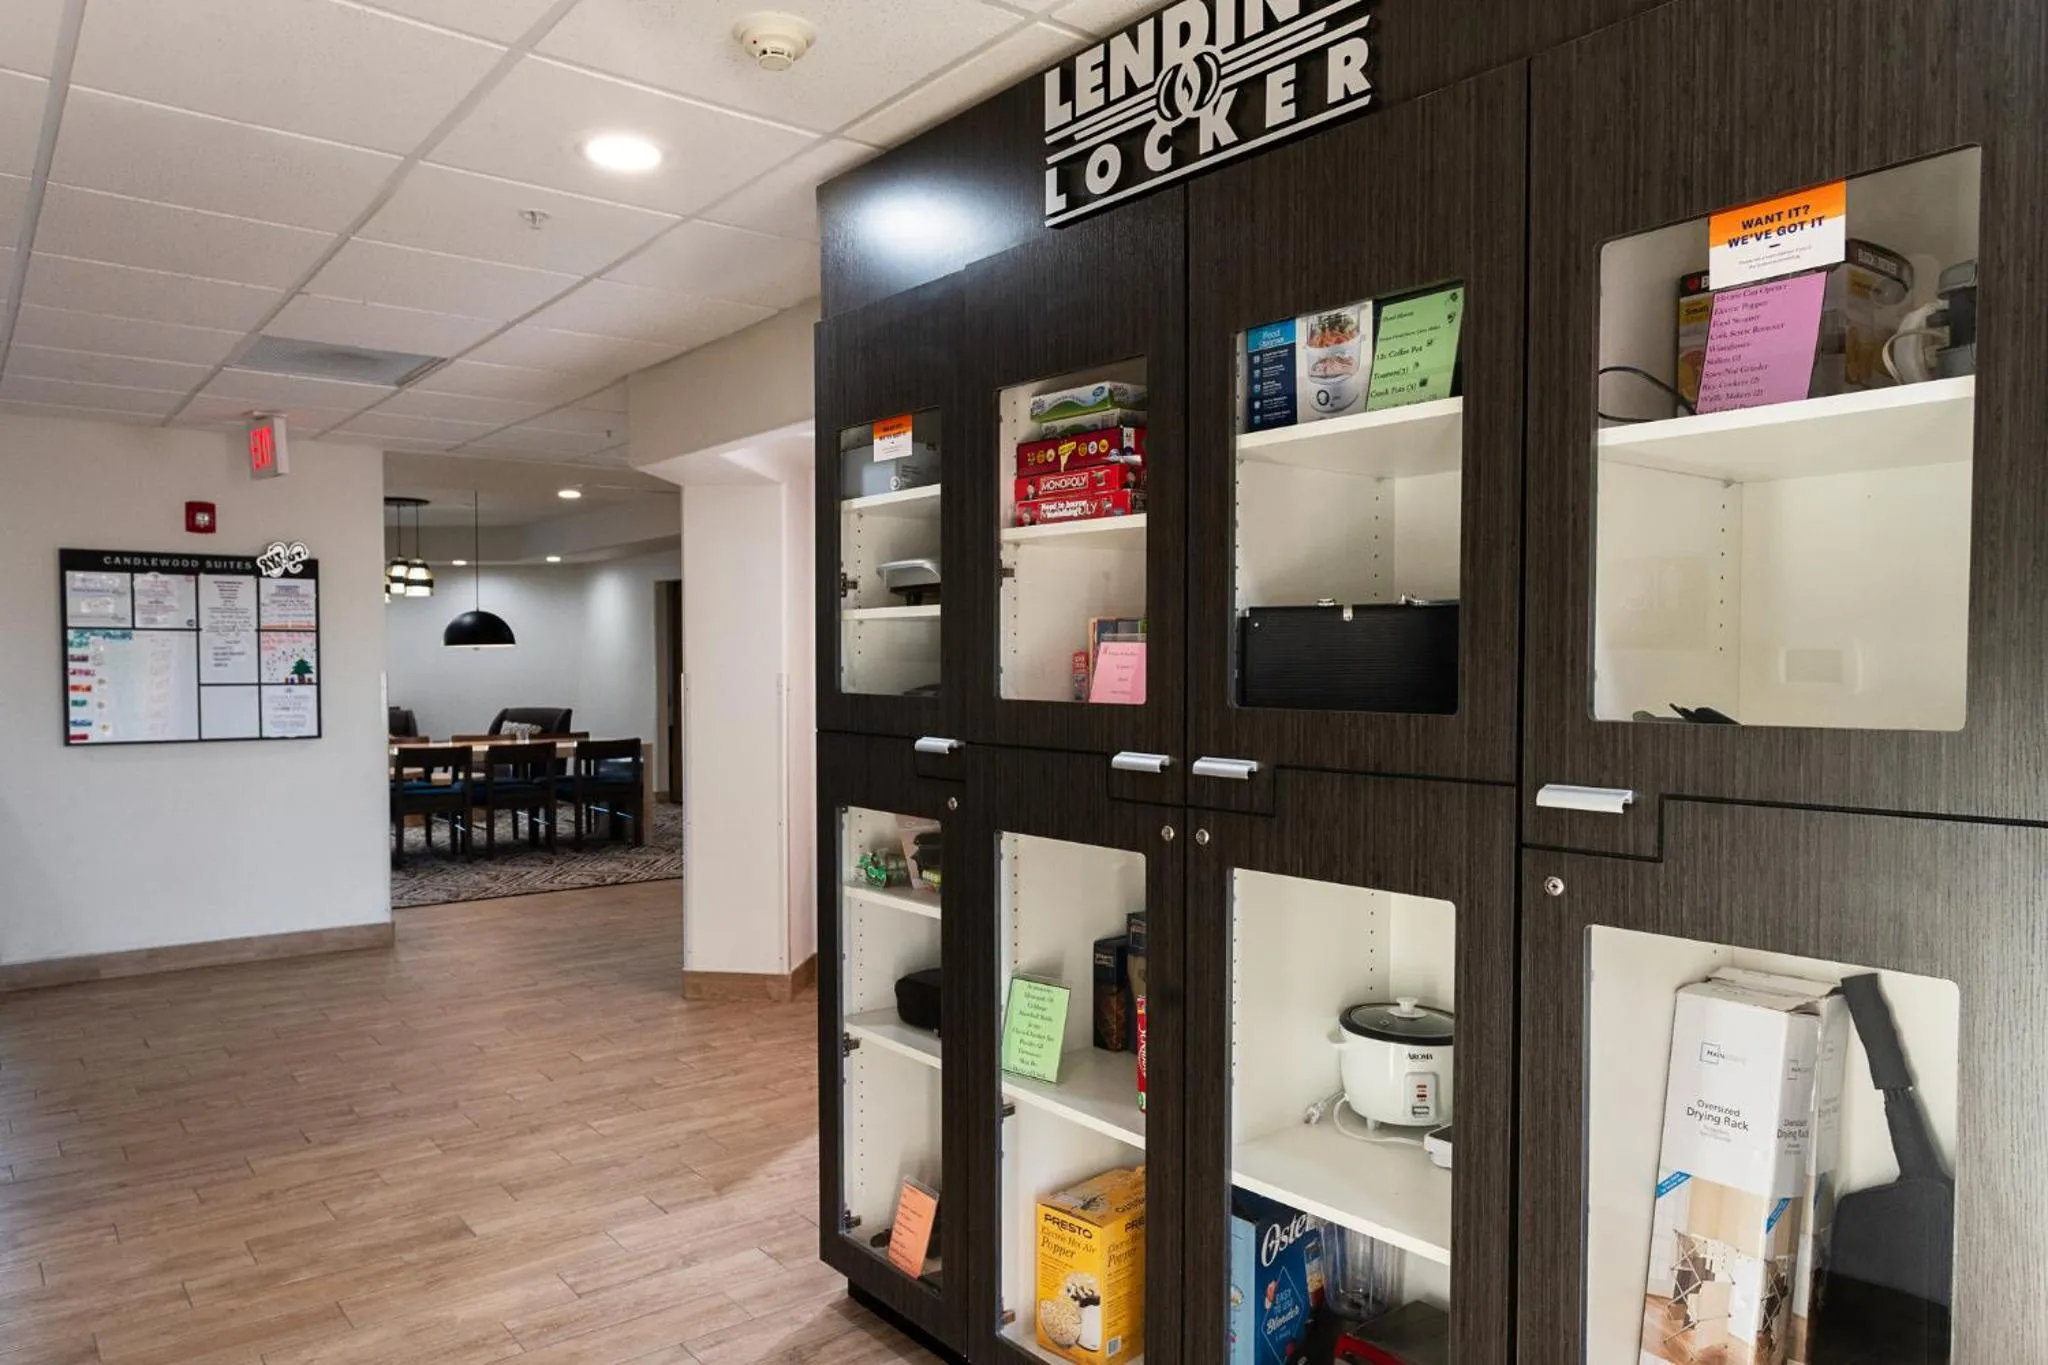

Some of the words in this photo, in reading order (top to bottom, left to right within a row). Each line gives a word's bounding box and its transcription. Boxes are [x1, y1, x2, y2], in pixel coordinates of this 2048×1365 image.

[1045, 37, 1371, 216] LOCKER
[1741, 211, 1784, 230] WANT
[1787, 204, 1811, 219] IT?
[1727, 230, 1773, 249] WE'VE
[1776, 220, 1809, 237] GOT
[1811, 215, 1825, 229] IT
[103, 556, 199, 569] CANDLEWOOD
[205, 559, 252, 570] SUITES
[1686, 1106, 1721, 1126] Drying
[1723, 1116, 1749, 1132] Rack
[1696, 1098, 1741, 1117] Oversized
[1043, 1213, 1093, 1240] PRESTO
